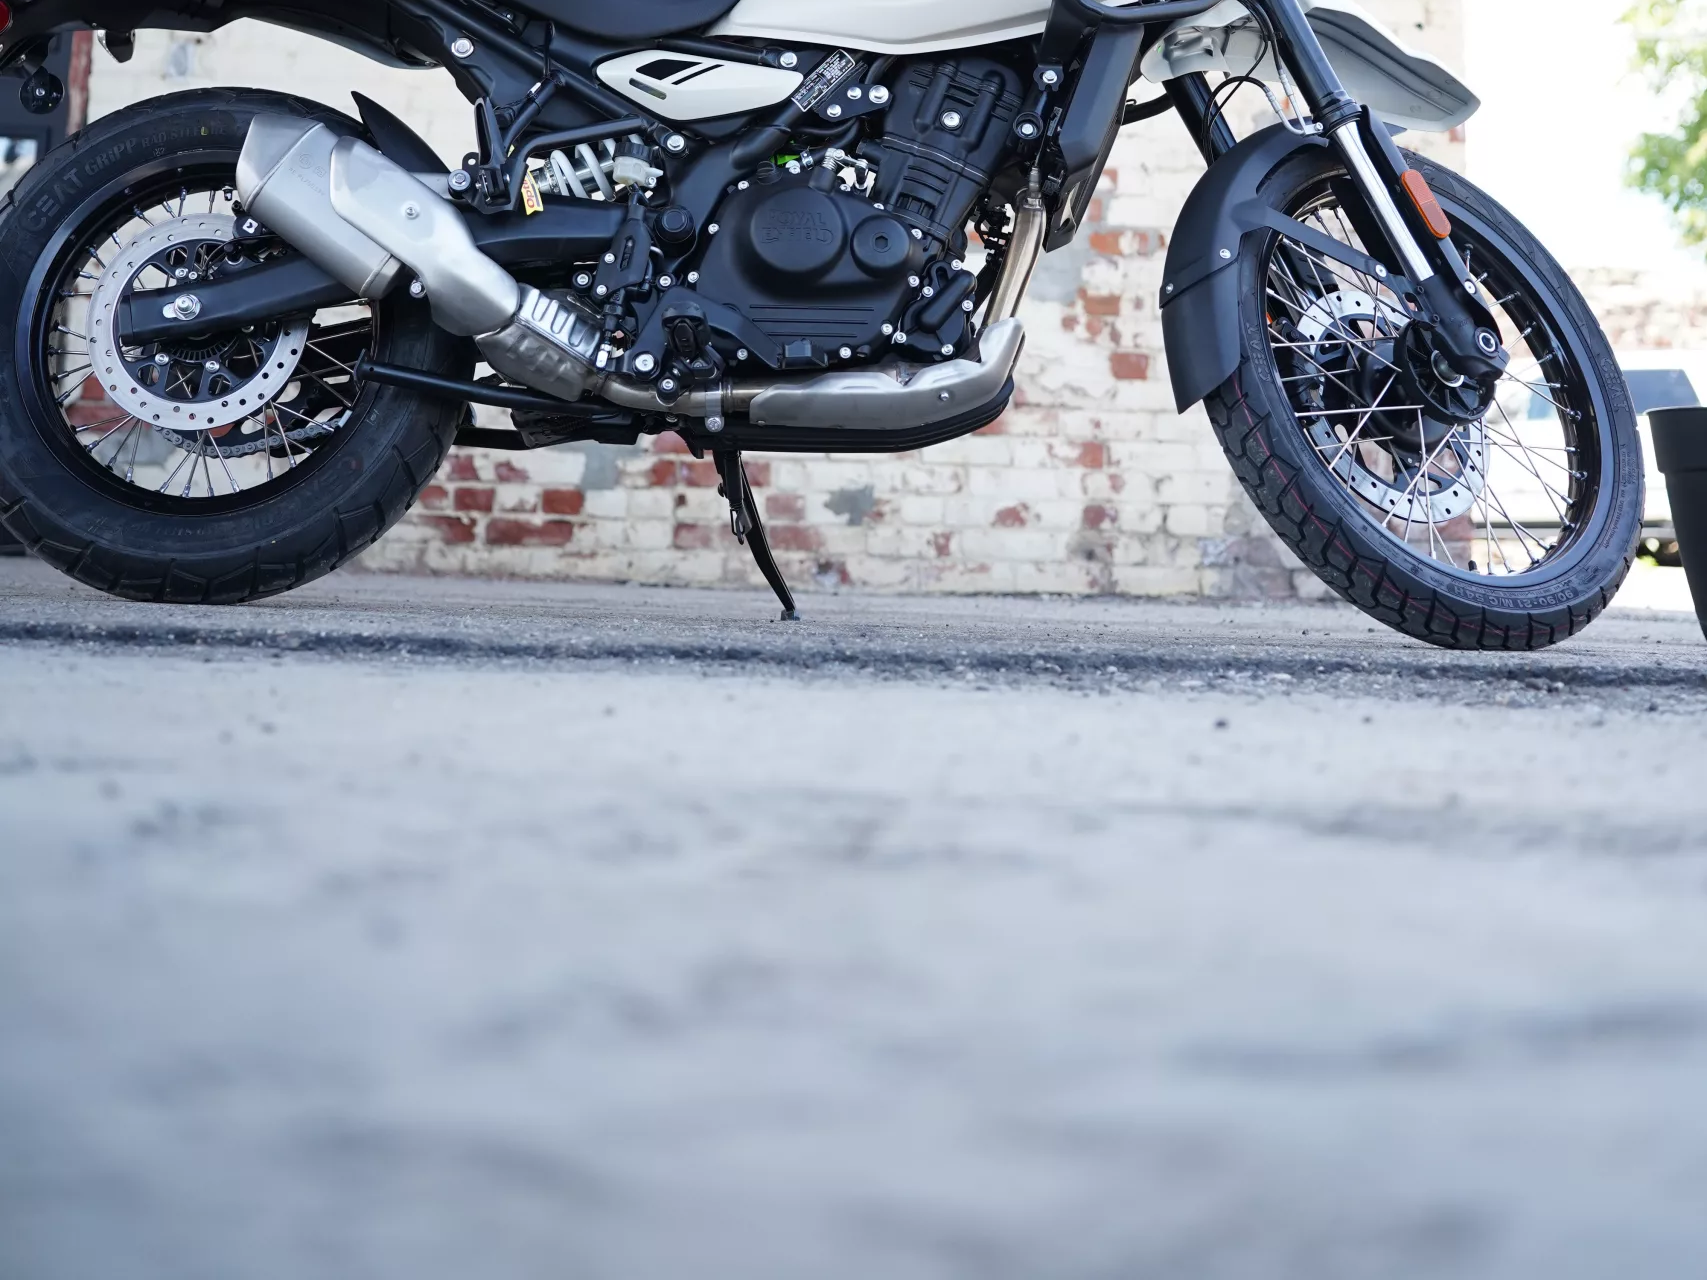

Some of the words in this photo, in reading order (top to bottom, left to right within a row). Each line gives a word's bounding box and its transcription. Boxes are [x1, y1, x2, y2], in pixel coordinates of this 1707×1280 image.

[19, 167, 83, 231] CEAT
[768, 208, 826, 226] ROYAL
[1600, 357, 1630, 413] CEAT
[1488, 596, 1514, 608] M/C
